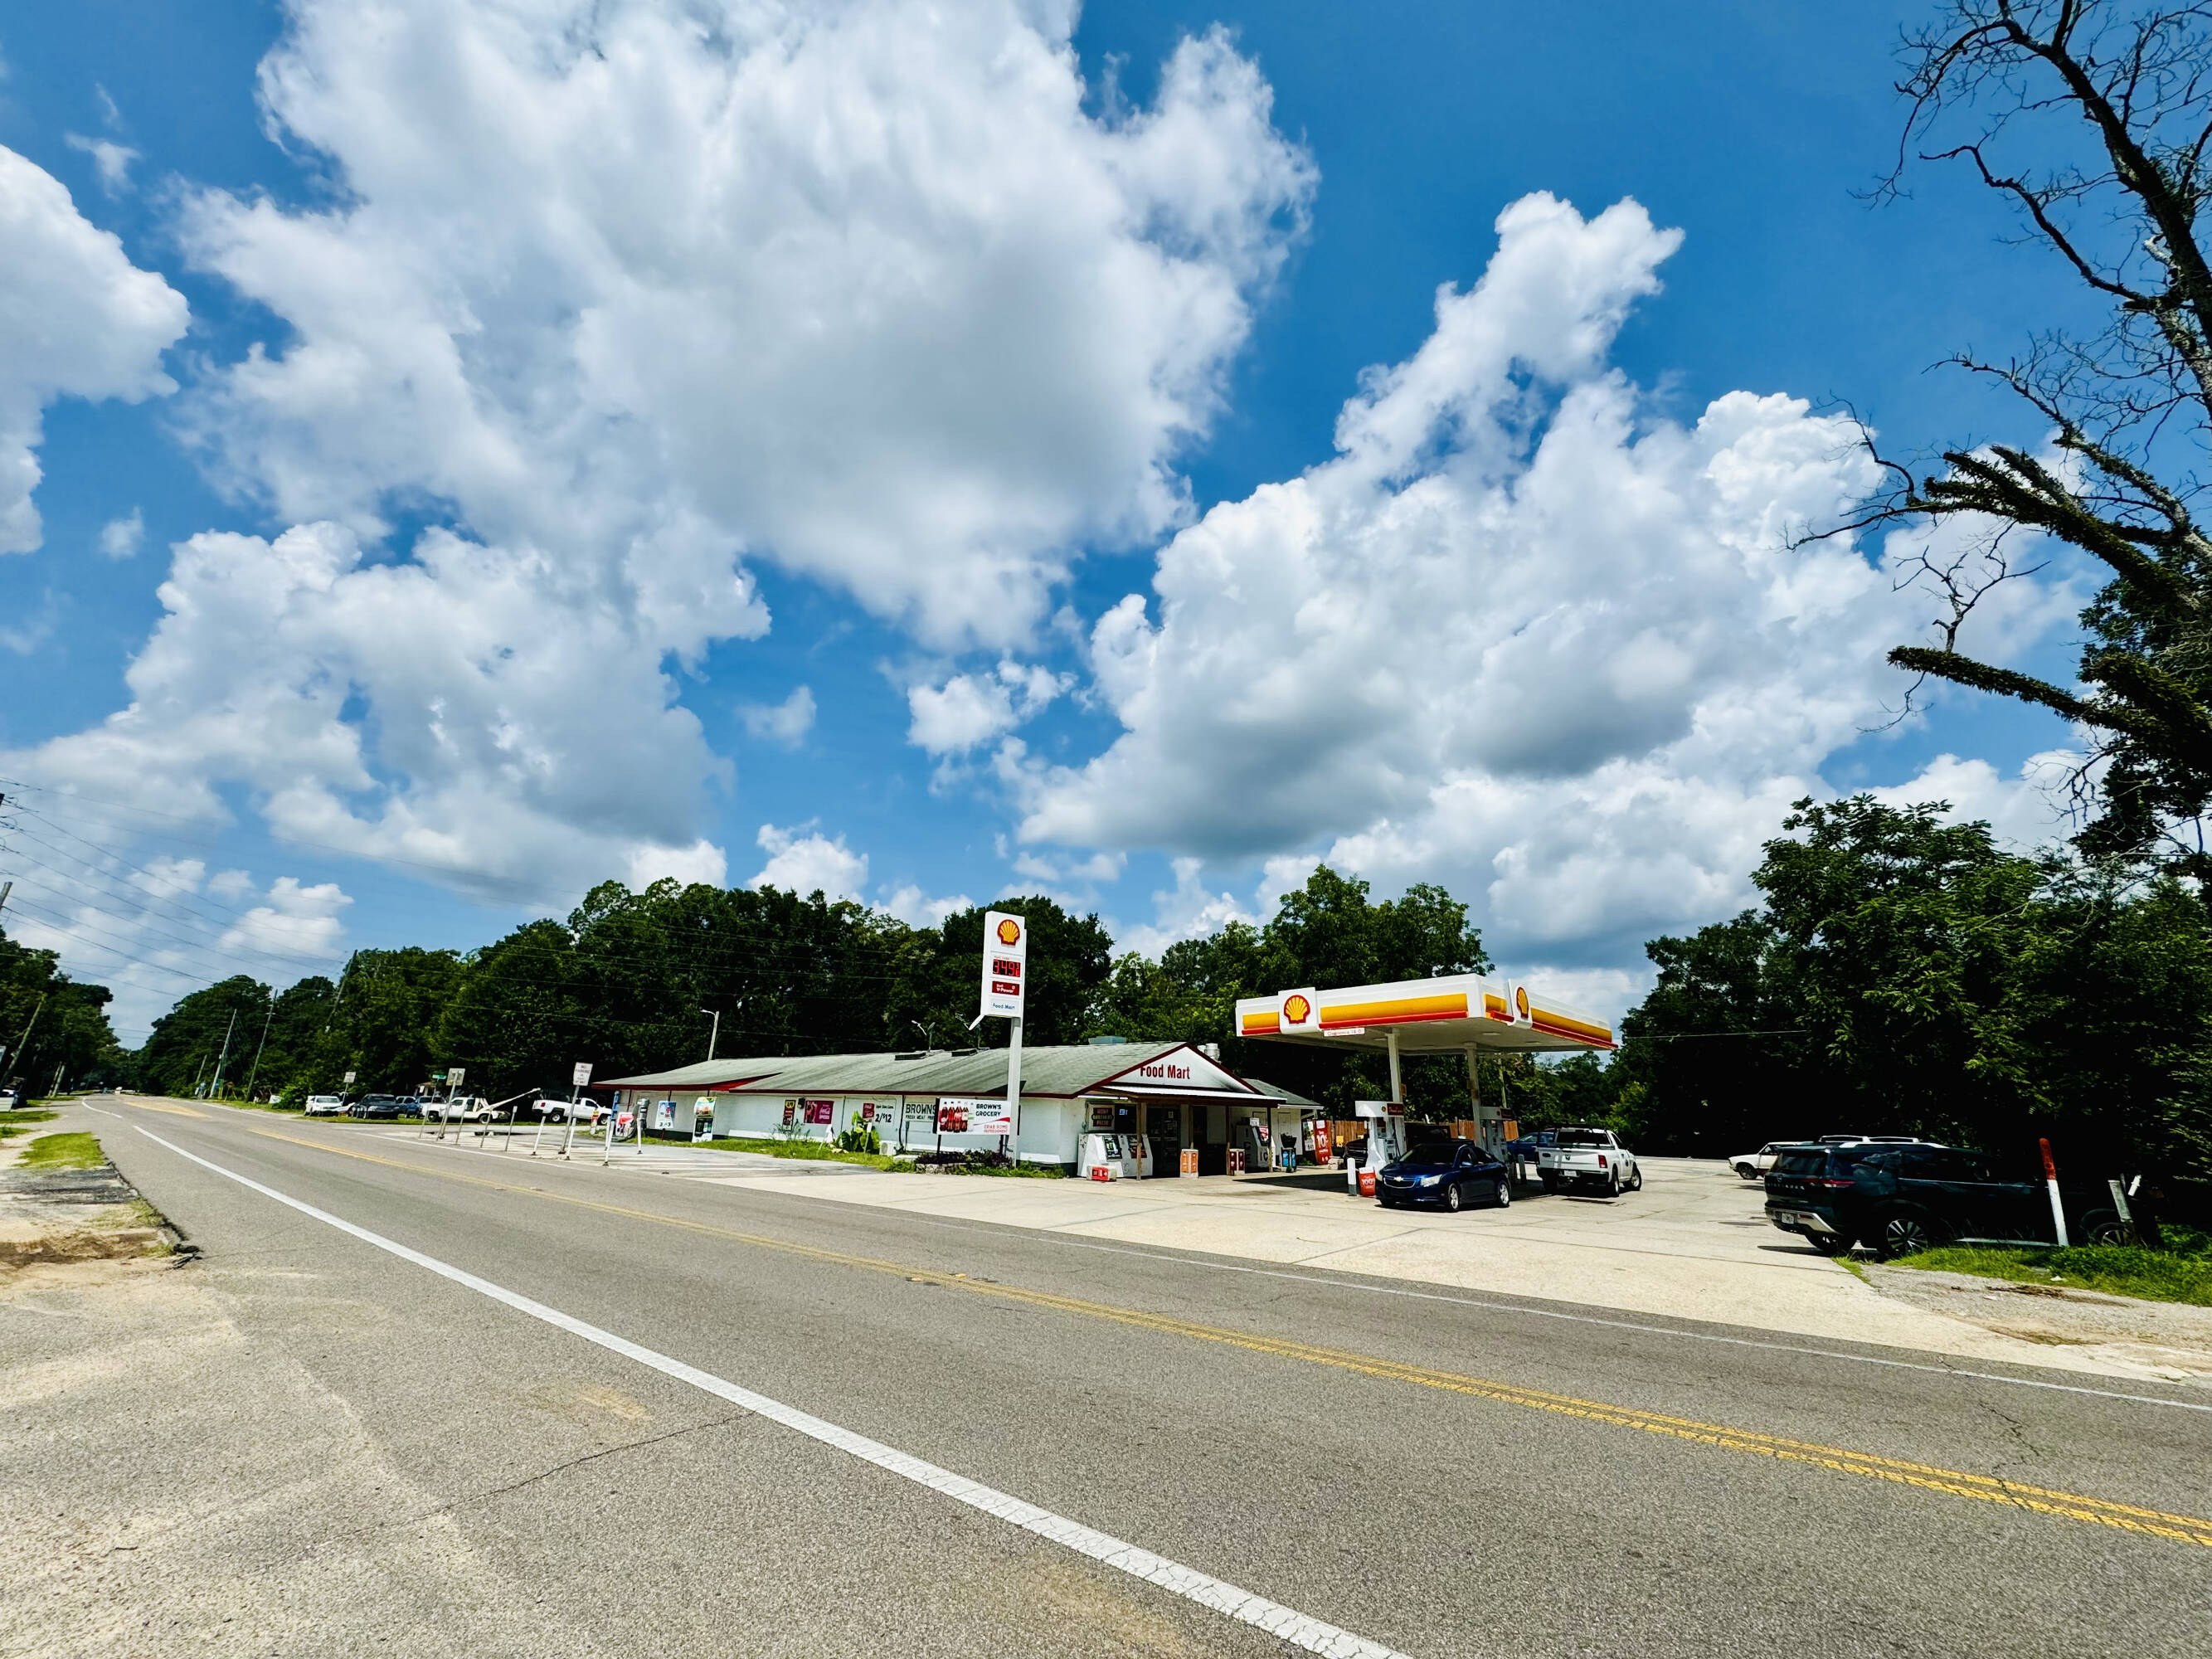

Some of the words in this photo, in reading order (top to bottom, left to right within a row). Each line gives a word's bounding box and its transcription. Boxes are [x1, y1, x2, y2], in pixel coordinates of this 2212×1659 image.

[1140, 1063, 1164, 1078] Food
[1167, 1064, 1190, 1079] Mart
[875, 1113, 892, 1122] 2/$12
